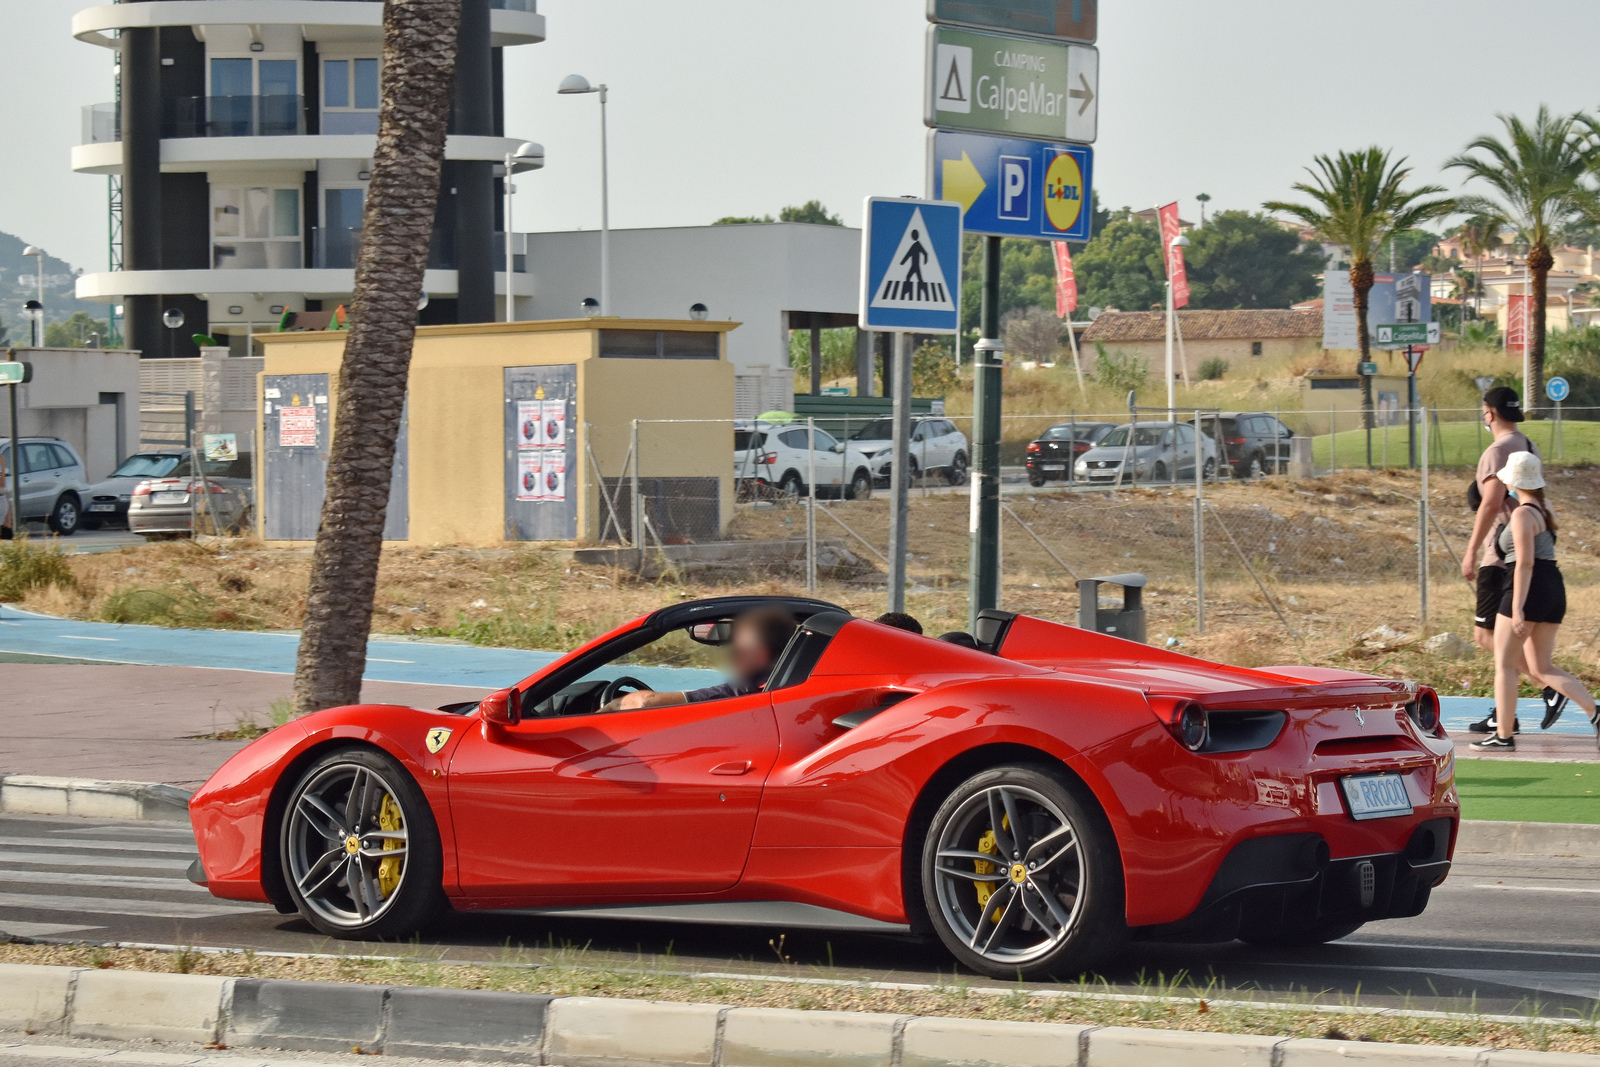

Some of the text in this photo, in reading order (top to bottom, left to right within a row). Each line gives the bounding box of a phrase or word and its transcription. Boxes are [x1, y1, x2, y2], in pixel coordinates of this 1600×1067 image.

[994, 50, 1046, 73] CAMPING
[976, 75, 1064, 120] CalpeMar
[1003, 163, 1026, 213] P
